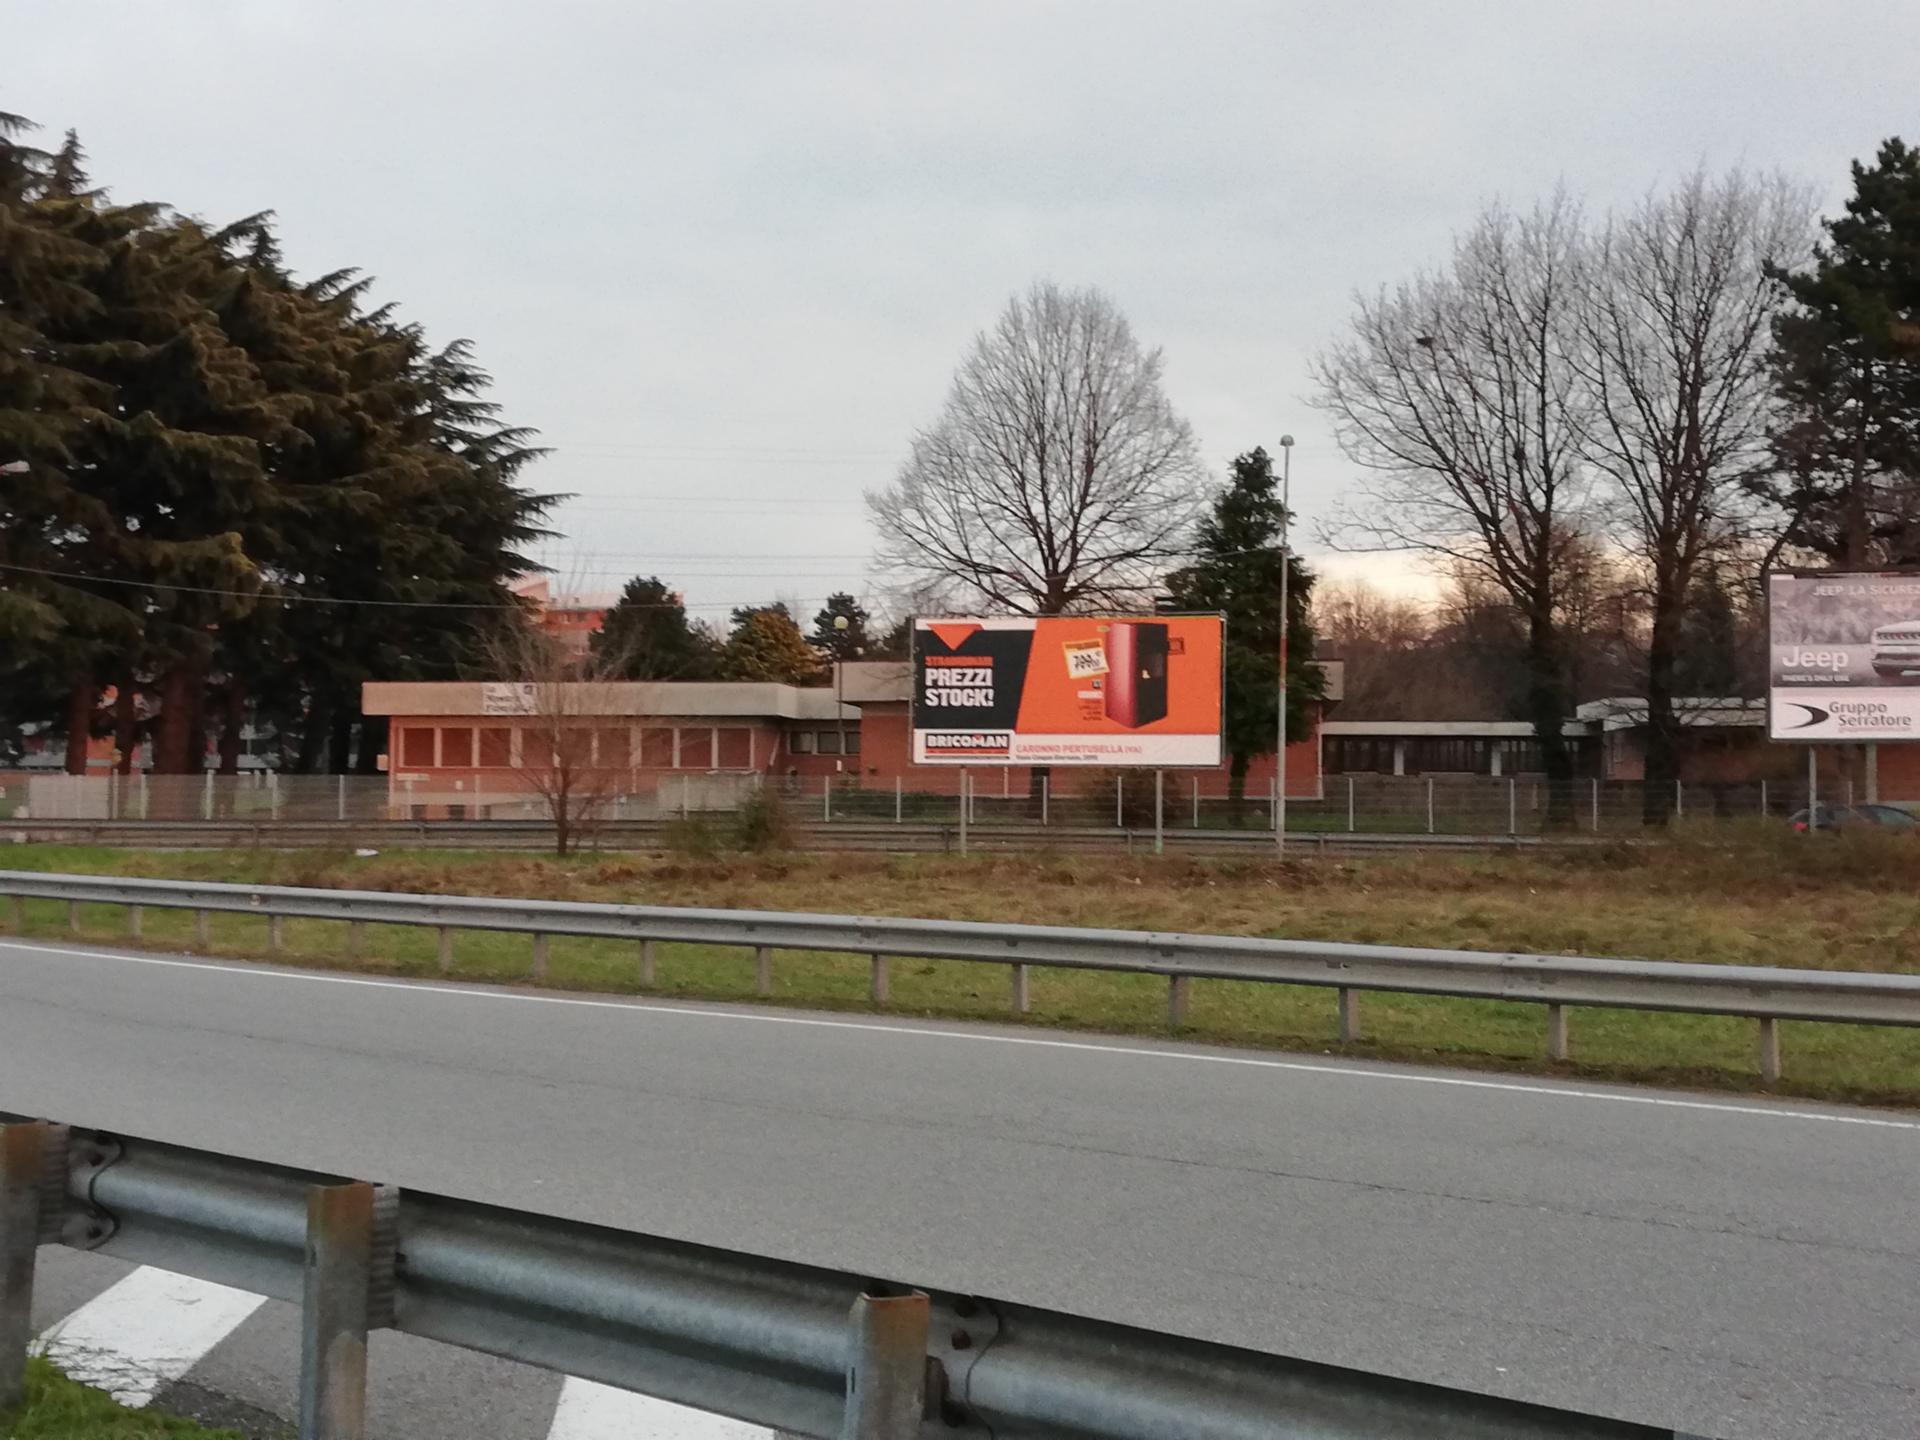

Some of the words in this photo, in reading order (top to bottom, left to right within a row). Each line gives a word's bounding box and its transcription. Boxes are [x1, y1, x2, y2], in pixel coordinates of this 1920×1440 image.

[1782, 646, 1849, 671] Jeep
[925, 668, 993, 687] PREZZI
[924, 688, 995, 707] STOCK!
[1829, 701, 1888, 716] Gruppo
[1838, 714, 1912, 727] Serratore
[926, 734, 1008, 748] BRICOMAN
